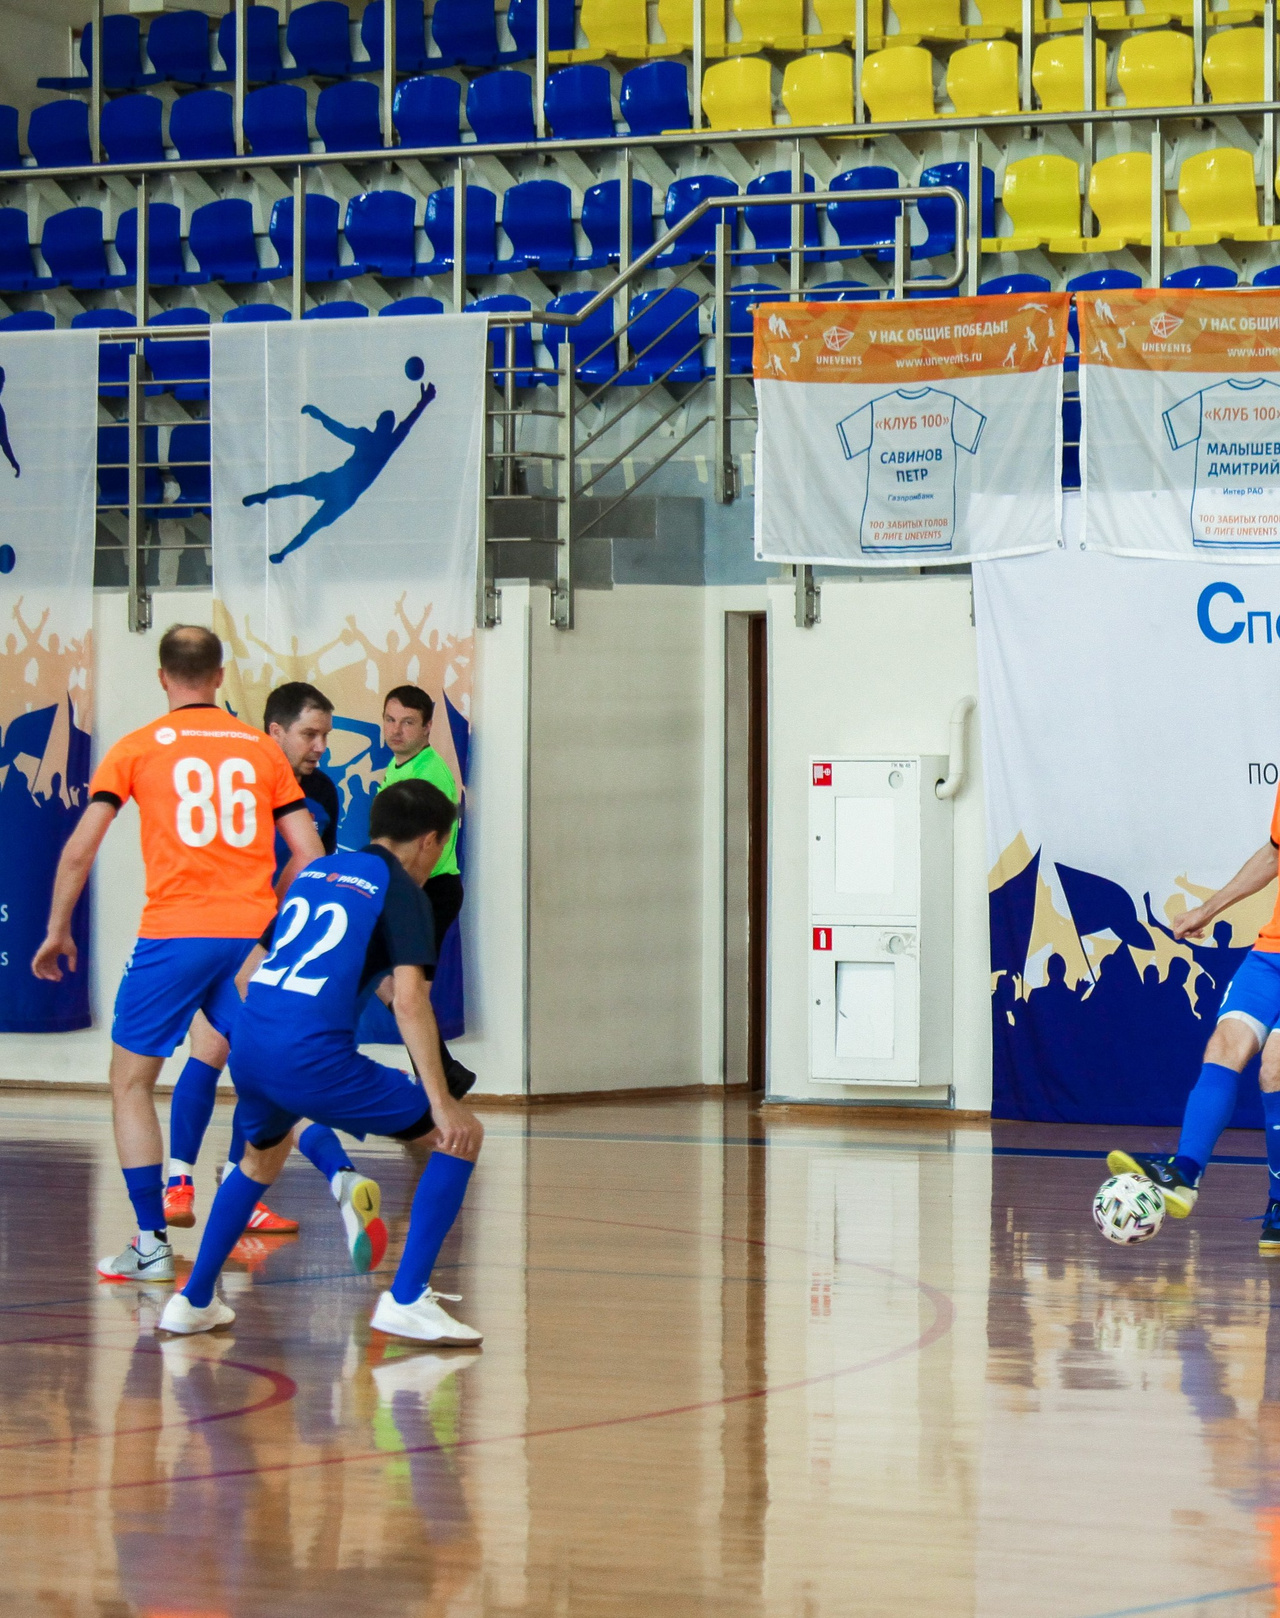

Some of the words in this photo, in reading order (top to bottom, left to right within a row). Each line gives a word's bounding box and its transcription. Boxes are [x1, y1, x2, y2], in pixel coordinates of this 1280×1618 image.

[1199, 318, 1208, 331] У
[1210, 317, 1237, 332] НАС
[869, 330, 878, 343] У
[880, 329, 904, 343] НАС
[907, 326, 951, 343] ОБЩИЕ
[954, 320, 1008, 338] ПОБЕДЫ!
[1142, 342, 1191, 353] UNEVENTS
[816, 356, 862, 365] UNEVENTS
[896, 352, 982, 368] www.unevents.ru
[1204, 407, 1249, 421] «КЛУБ
[875, 417, 917, 430] «КЛУБ
[921, 415, 950, 428] 100»
[880, 448, 943, 464] САВИНОВ
[1207, 459, 1280, 477] ДМИТРИЙ
[896, 469, 928, 482] ПЕТР
[887, 493, 934, 502] Газпромбанк
[1222, 487, 1246, 496] Интер
[1247, 487, 1263, 496] РАО
[869, 520, 884, 530] 100
[887, 519, 923, 529] ЗАБИТЫХ
[924, 517, 948, 528] ГОЛОВ
[1199, 513, 1215, 524] 100
[1217, 514, 1256, 524] ЗАБИТЫХ
[874, 532, 879, 540] В
[881, 531, 903, 541] ЛИГЕ
[905, 530, 942, 540] UNEVENTS
[1205, 526, 1211, 535] В
[1213, 526, 1235, 536] ЛИГЕ
[1237, 526, 1278, 536] UNEVENTS
[173, 757, 257, 848] 86
[250, 896, 348, 997] 22
